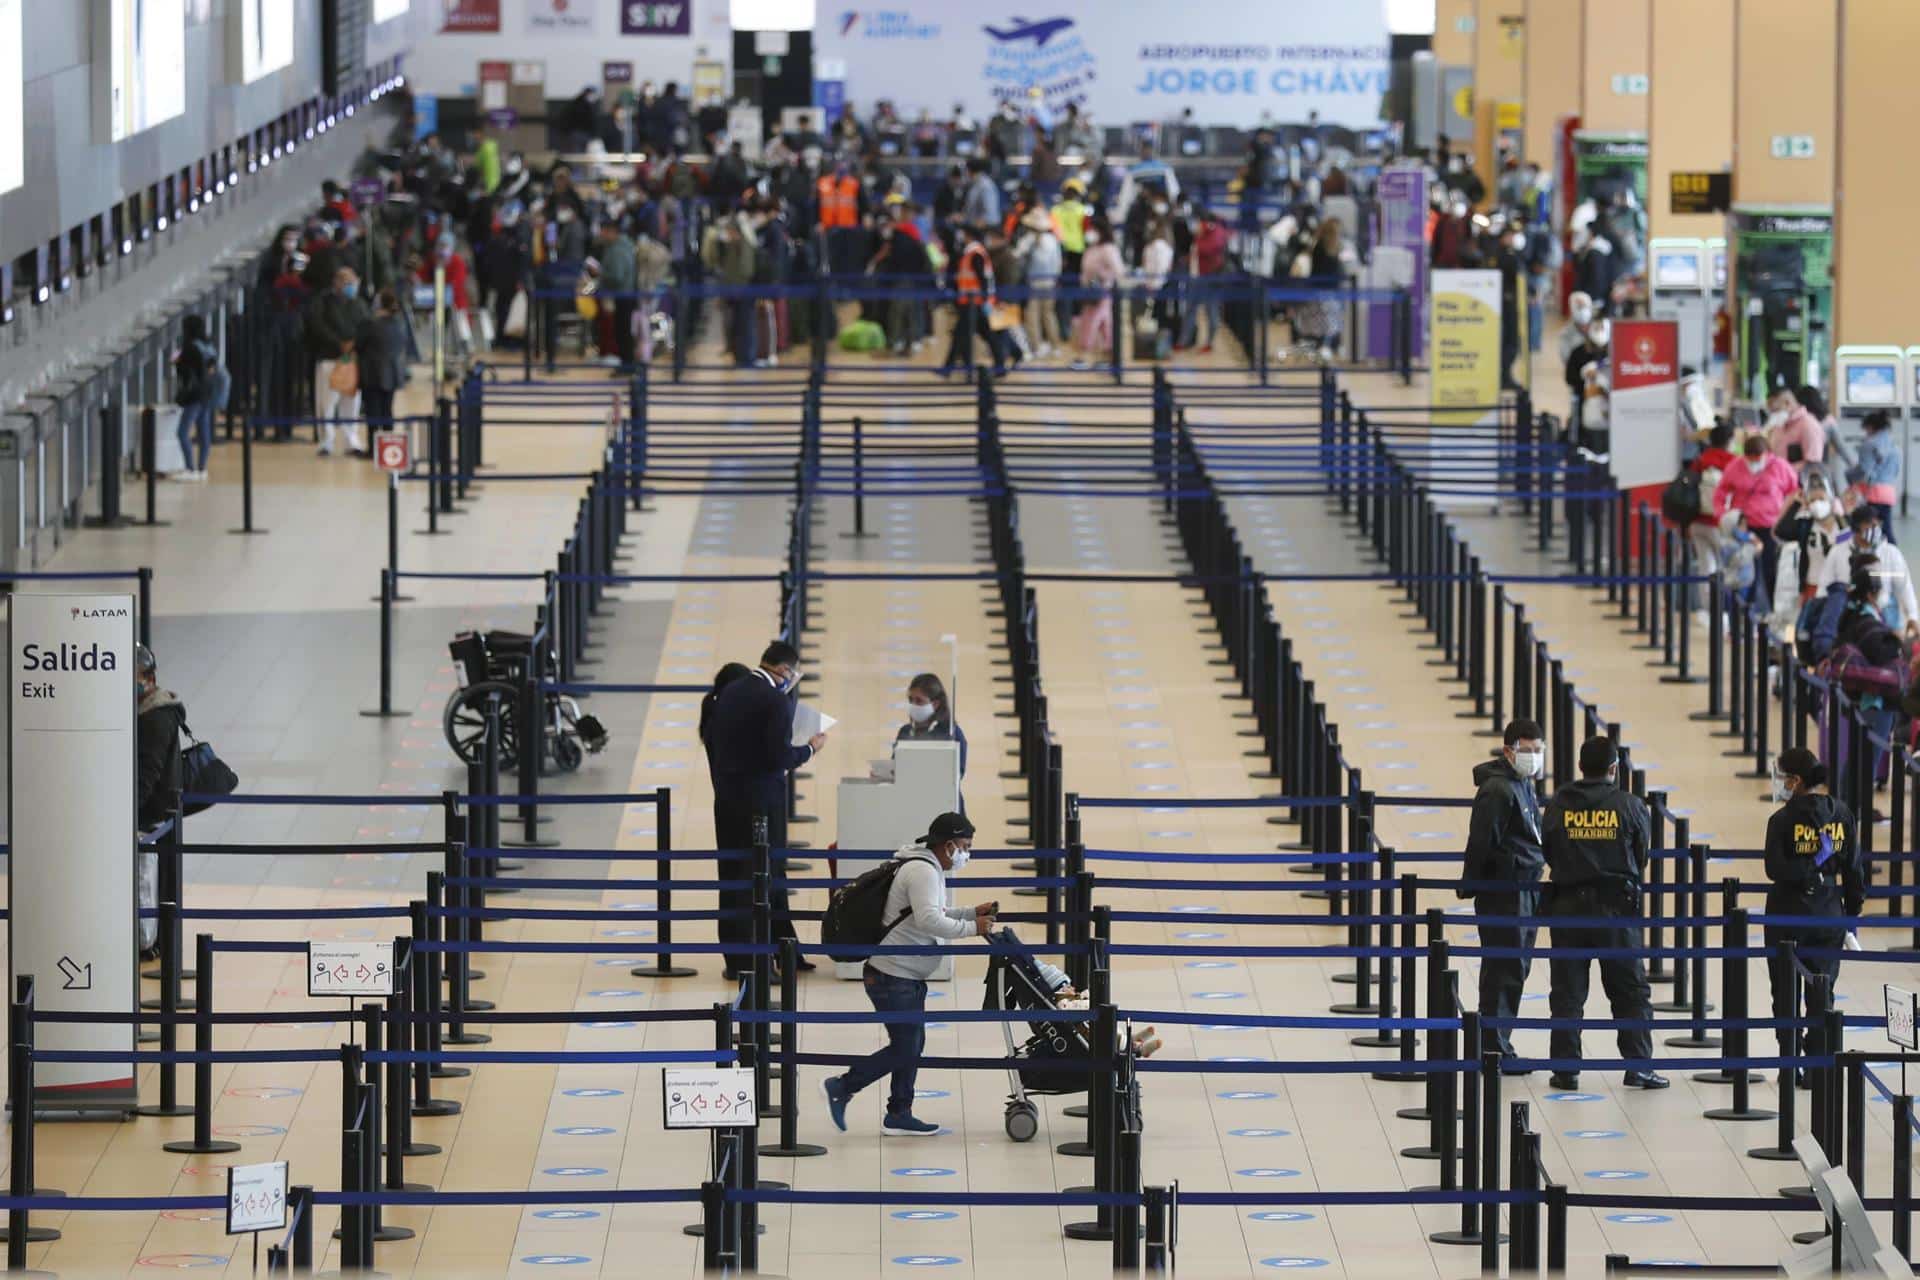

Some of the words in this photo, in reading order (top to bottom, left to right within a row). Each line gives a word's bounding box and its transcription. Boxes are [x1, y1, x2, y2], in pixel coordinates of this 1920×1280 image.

[1138, 44, 1271, 60] AEROPUERTO
[1136, 68, 1259, 95] JORGE
[82, 608, 128, 618] LATAM
[23, 643, 116, 671] Salida
[21, 682, 56, 699] Exit
[1564, 809, 1619, 828] POLICIA
